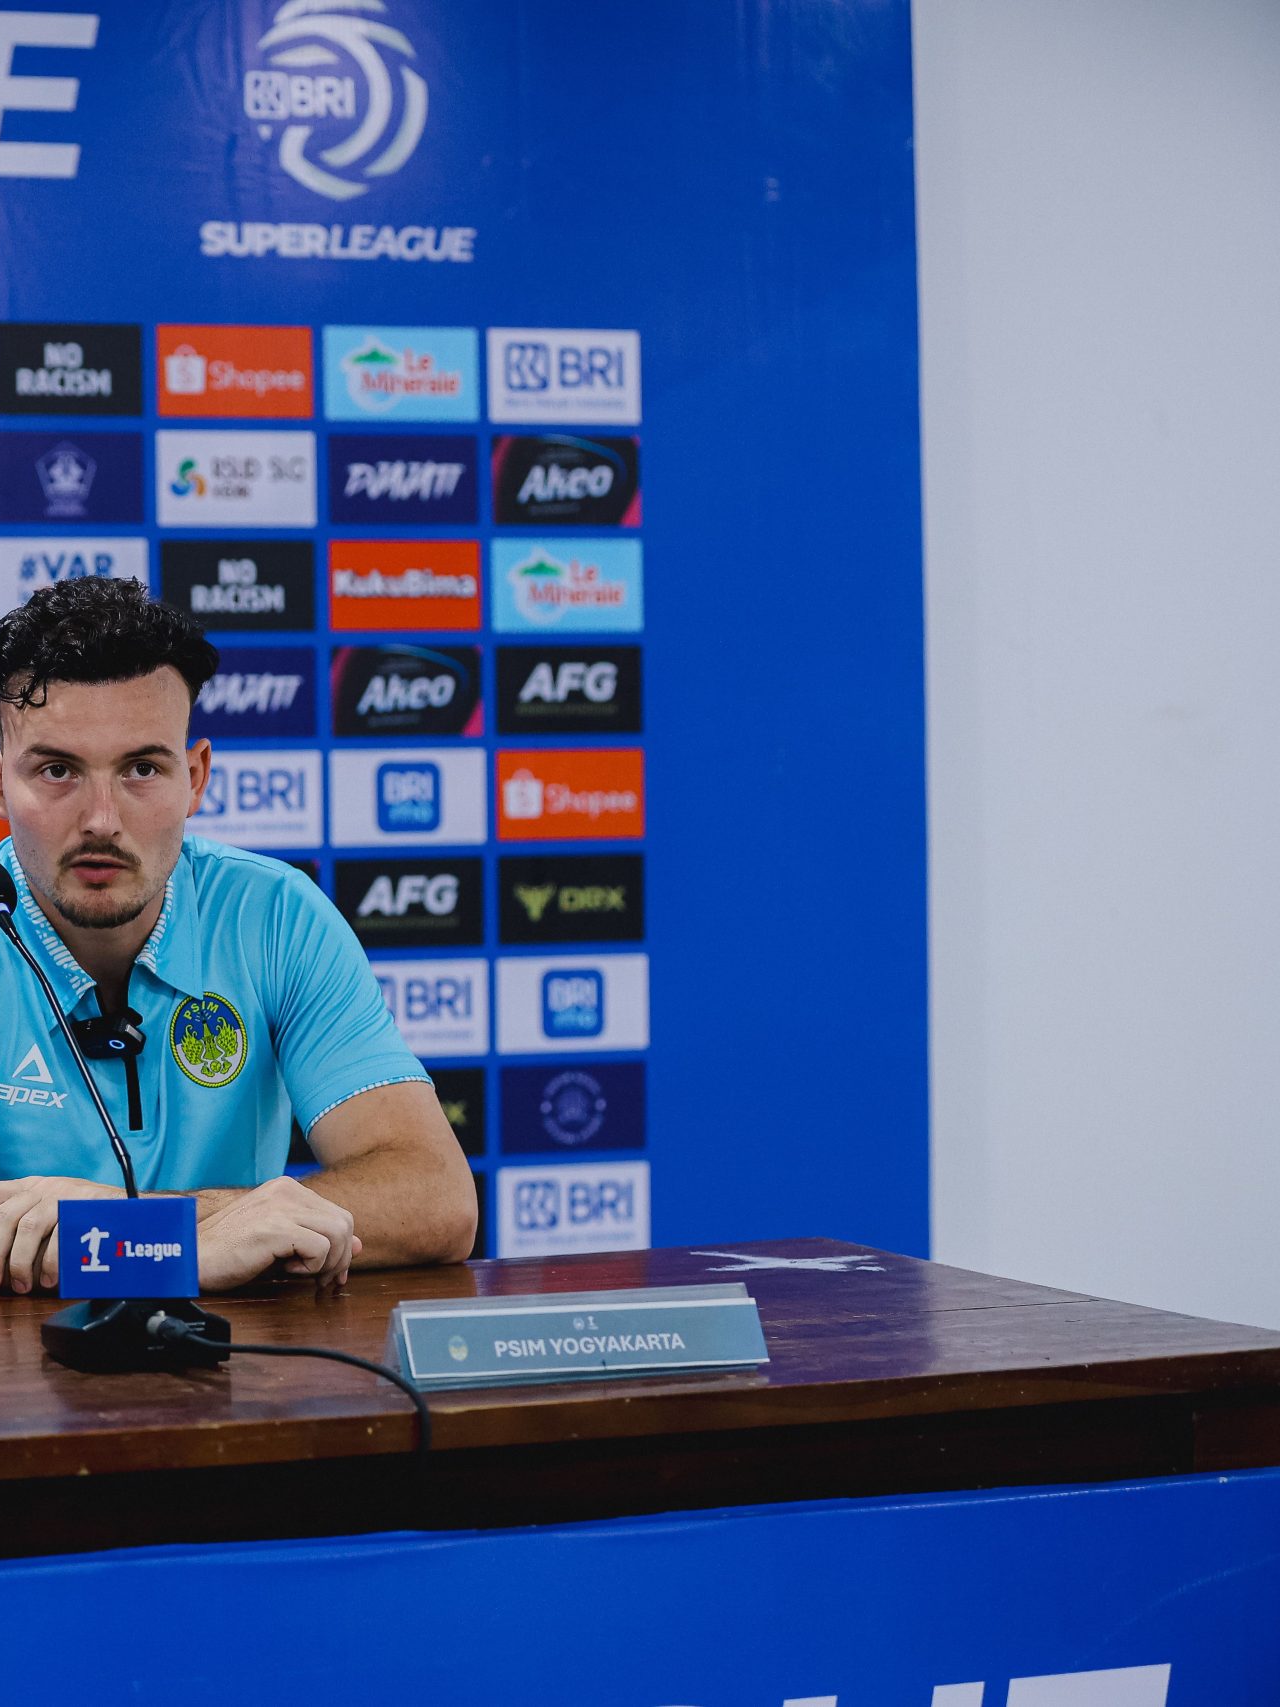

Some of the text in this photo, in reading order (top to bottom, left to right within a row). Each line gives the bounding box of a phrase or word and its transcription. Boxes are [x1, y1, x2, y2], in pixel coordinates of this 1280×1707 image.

[290, 74, 357, 118] BRI
[43, 342, 83, 367] NO
[403, 350, 432, 373] Le
[558, 347, 624, 388] BRI
[16, 367, 112, 396] RACISM
[208, 360, 306, 398] Shopee
[517, 464, 614, 504] Akeo
[21, 551, 113, 580] #VAR
[218, 558, 257, 584] NO
[570, 561, 599, 583] Le
[191, 584, 285, 613] RACISM
[357, 674, 456, 716] Akeo
[519, 662, 618, 703] AFG
[236, 769, 307, 812] BRI
[383, 770, 434, 803] BRI
[544, 783, 637, 820] Shopee
[356, 874, 460, 916] AFG
[183, 1000, 219, 1020] PSIM
[405, 977, 472, 1021] BRI
[548, 976, 598, 1010] BRI
[569, 1181, 634, 1225] BRI
[495, 1333, 686, 1358] PSIM YOGYAKARTA
